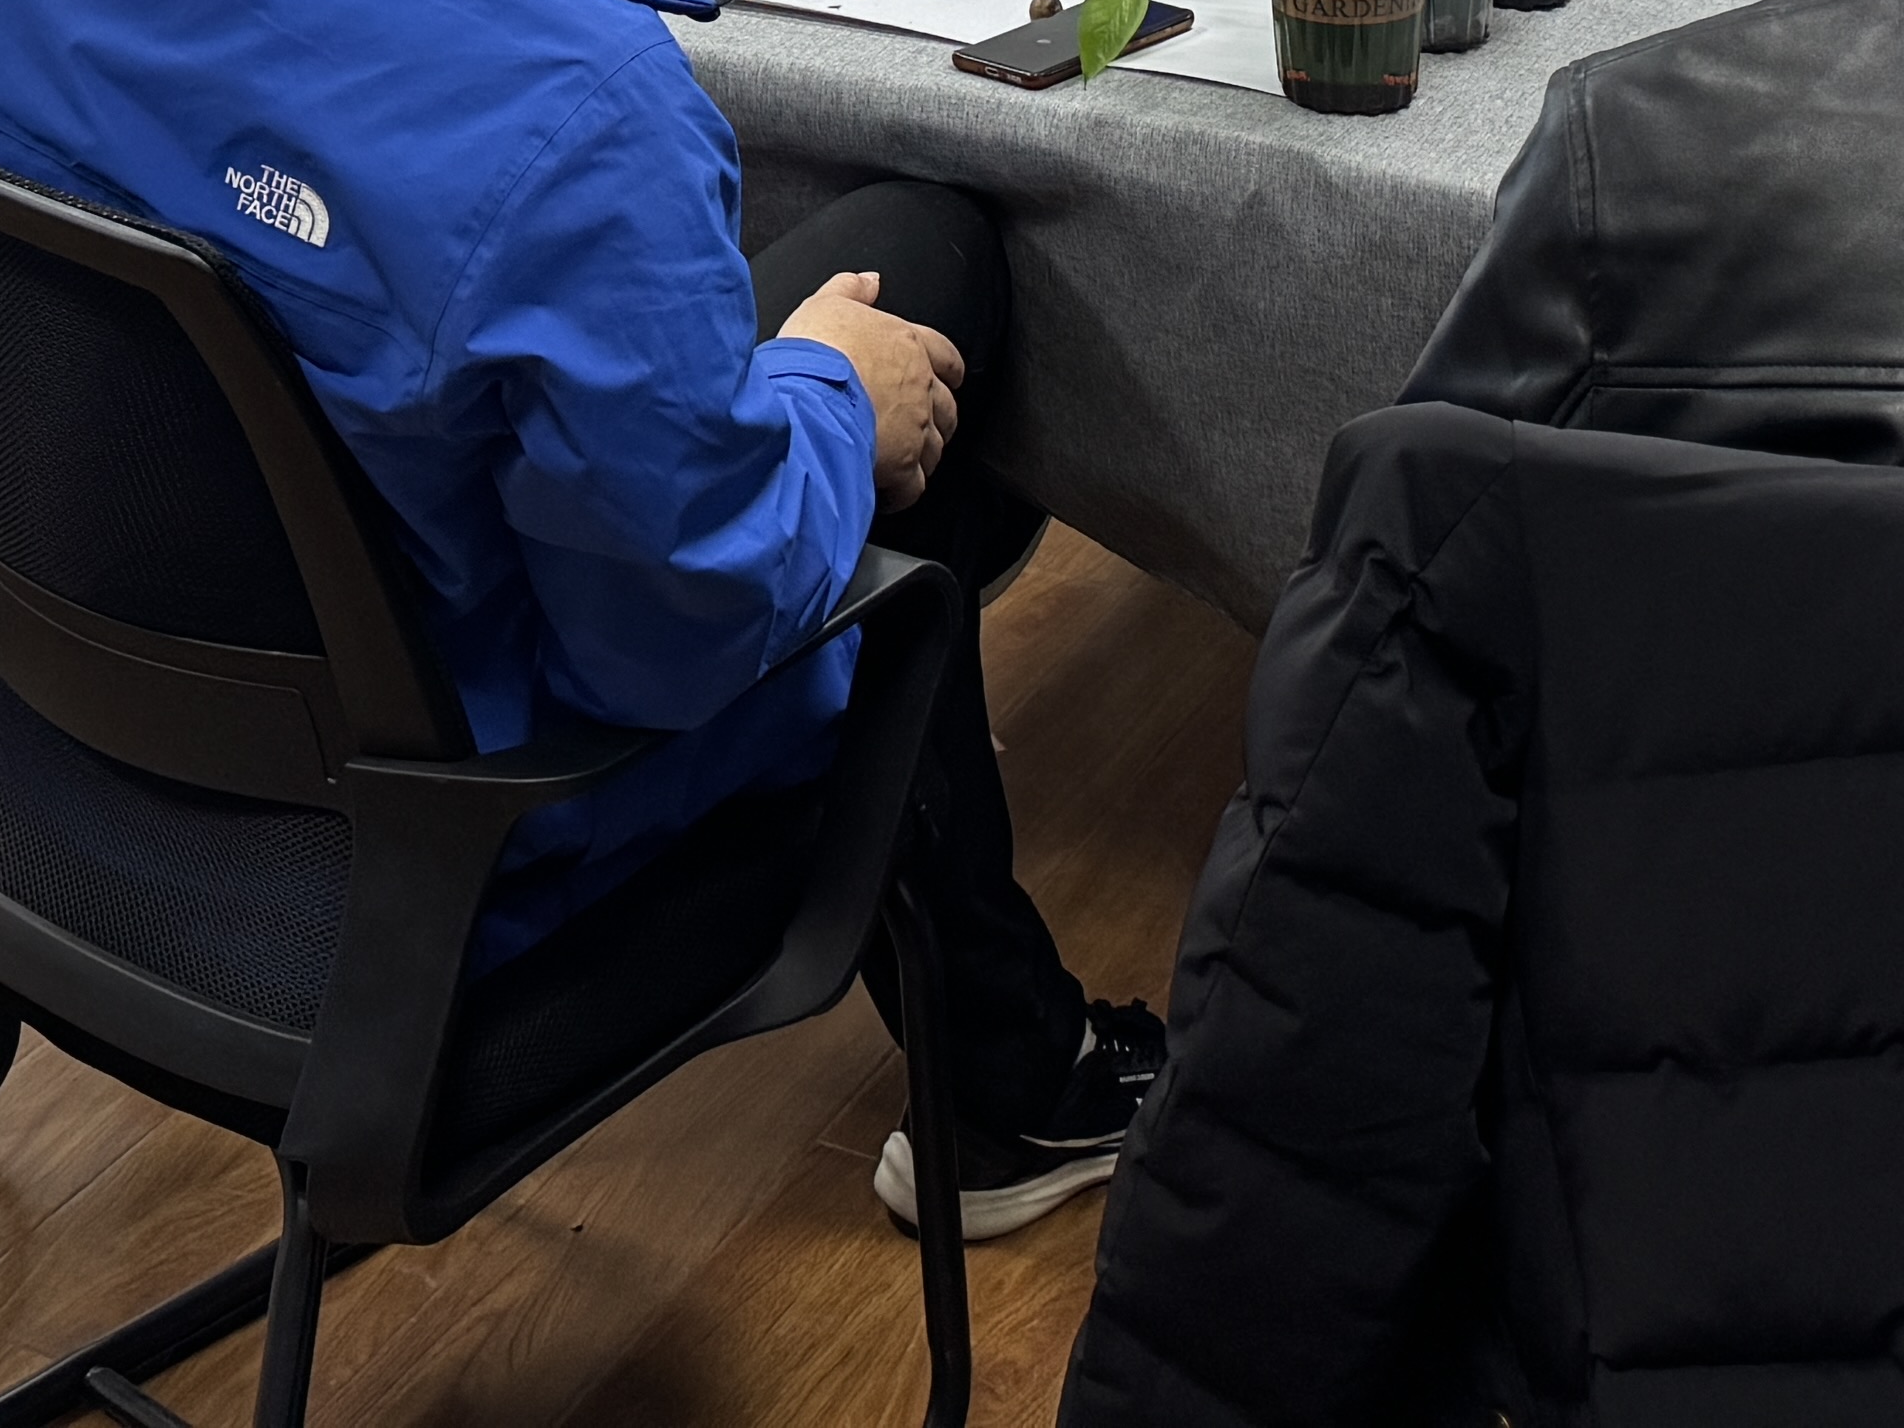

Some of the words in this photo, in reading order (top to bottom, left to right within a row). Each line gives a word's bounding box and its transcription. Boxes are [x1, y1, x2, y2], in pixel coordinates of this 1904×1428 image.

[224, 166, 297, 214] NORTH
[260, 164, 302, 196] THE
[236, 193, 290, 231] FACE
